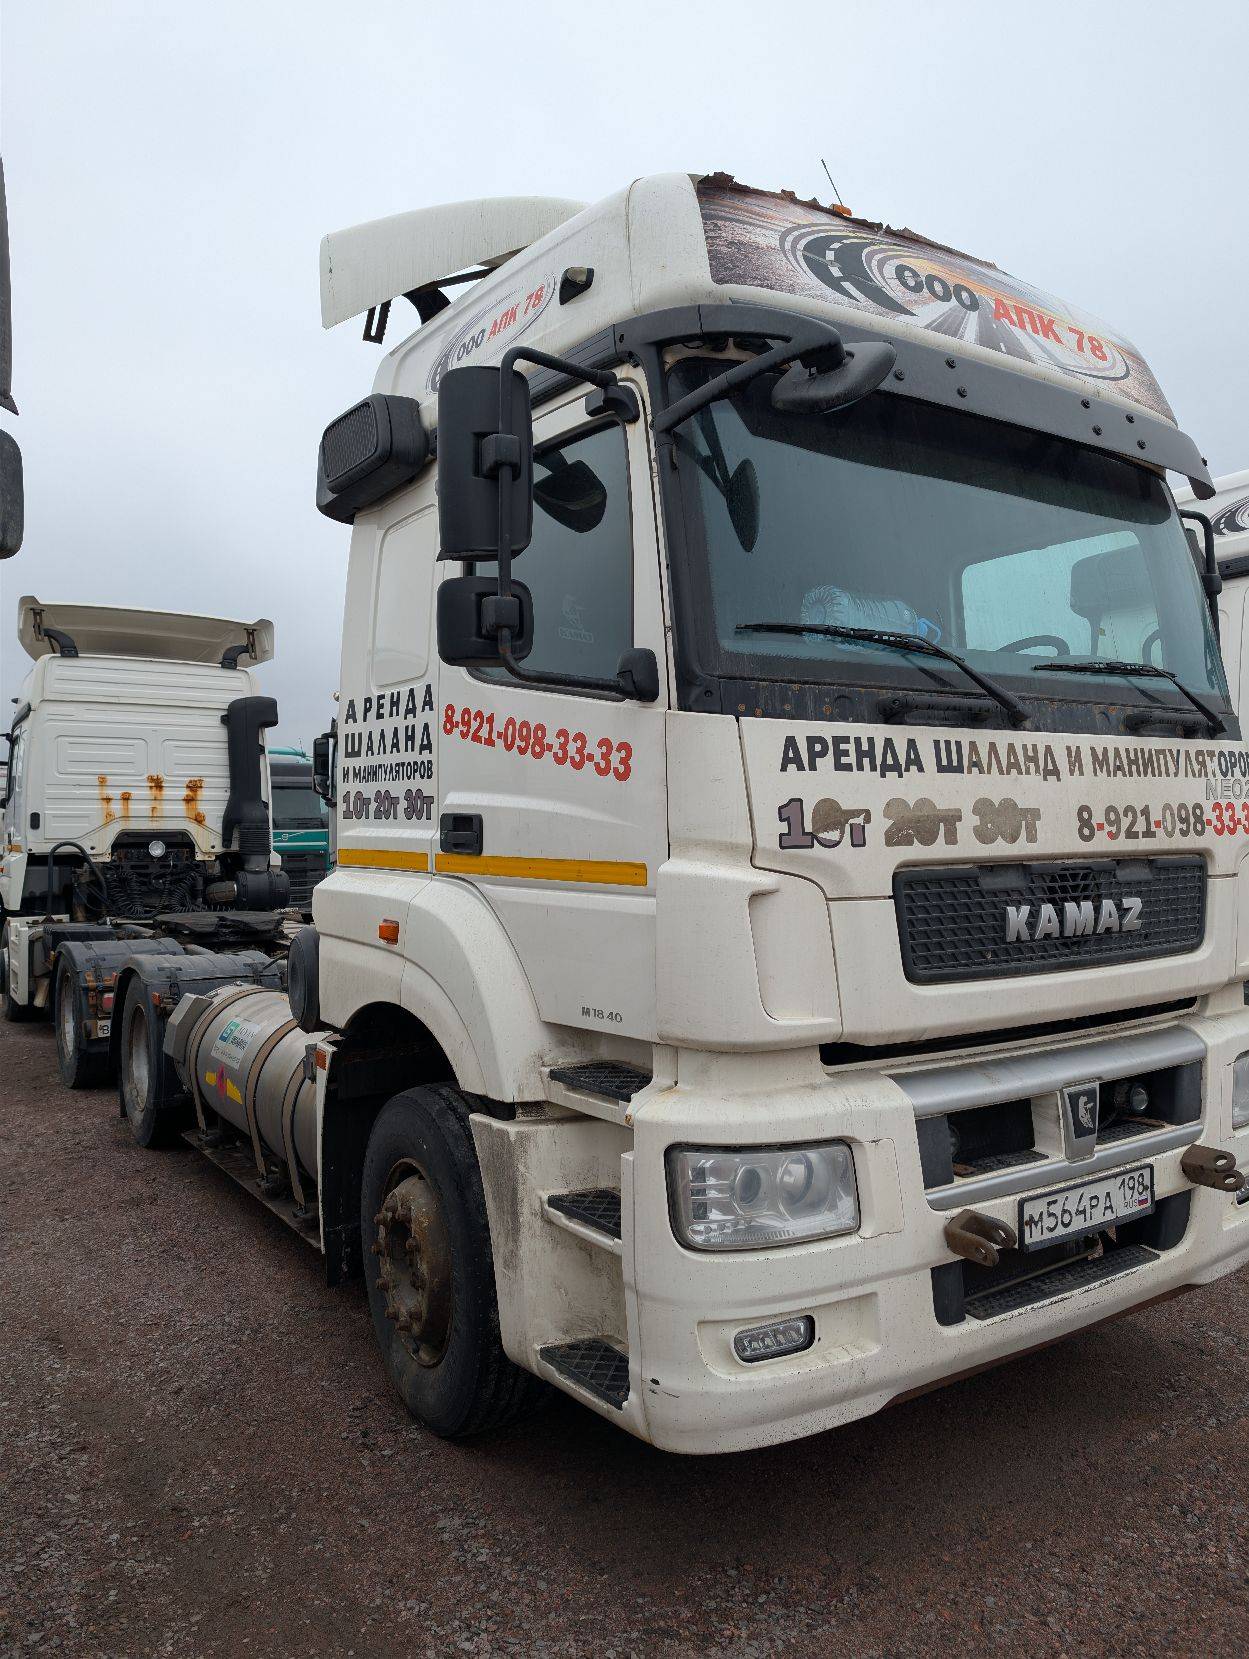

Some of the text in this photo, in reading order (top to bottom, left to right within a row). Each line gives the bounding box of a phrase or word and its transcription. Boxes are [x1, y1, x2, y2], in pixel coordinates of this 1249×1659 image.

[456, 284, 545, 361] ООО АПК 78
[894, 263, 1108, 362] ООО АПК 78
[345, 684, 434, 724] АРЕНДА
[345, 722, 433, 758] ШАЛАНД
[443, 703, 632, 782] 8-921-098-33-33
[780, 735, 925, 779] АРЕНДА
[933, 738, 1061, 782] ШАЛАНД
[1066, 745, 1083, 777] И
[343, 760, 433, 784] И МАНИПУЛЯТОРОВ
[1005, 897, 1143, 942] KAMAZ
[1028, 1172, 1145, 1239] М564РА 198
